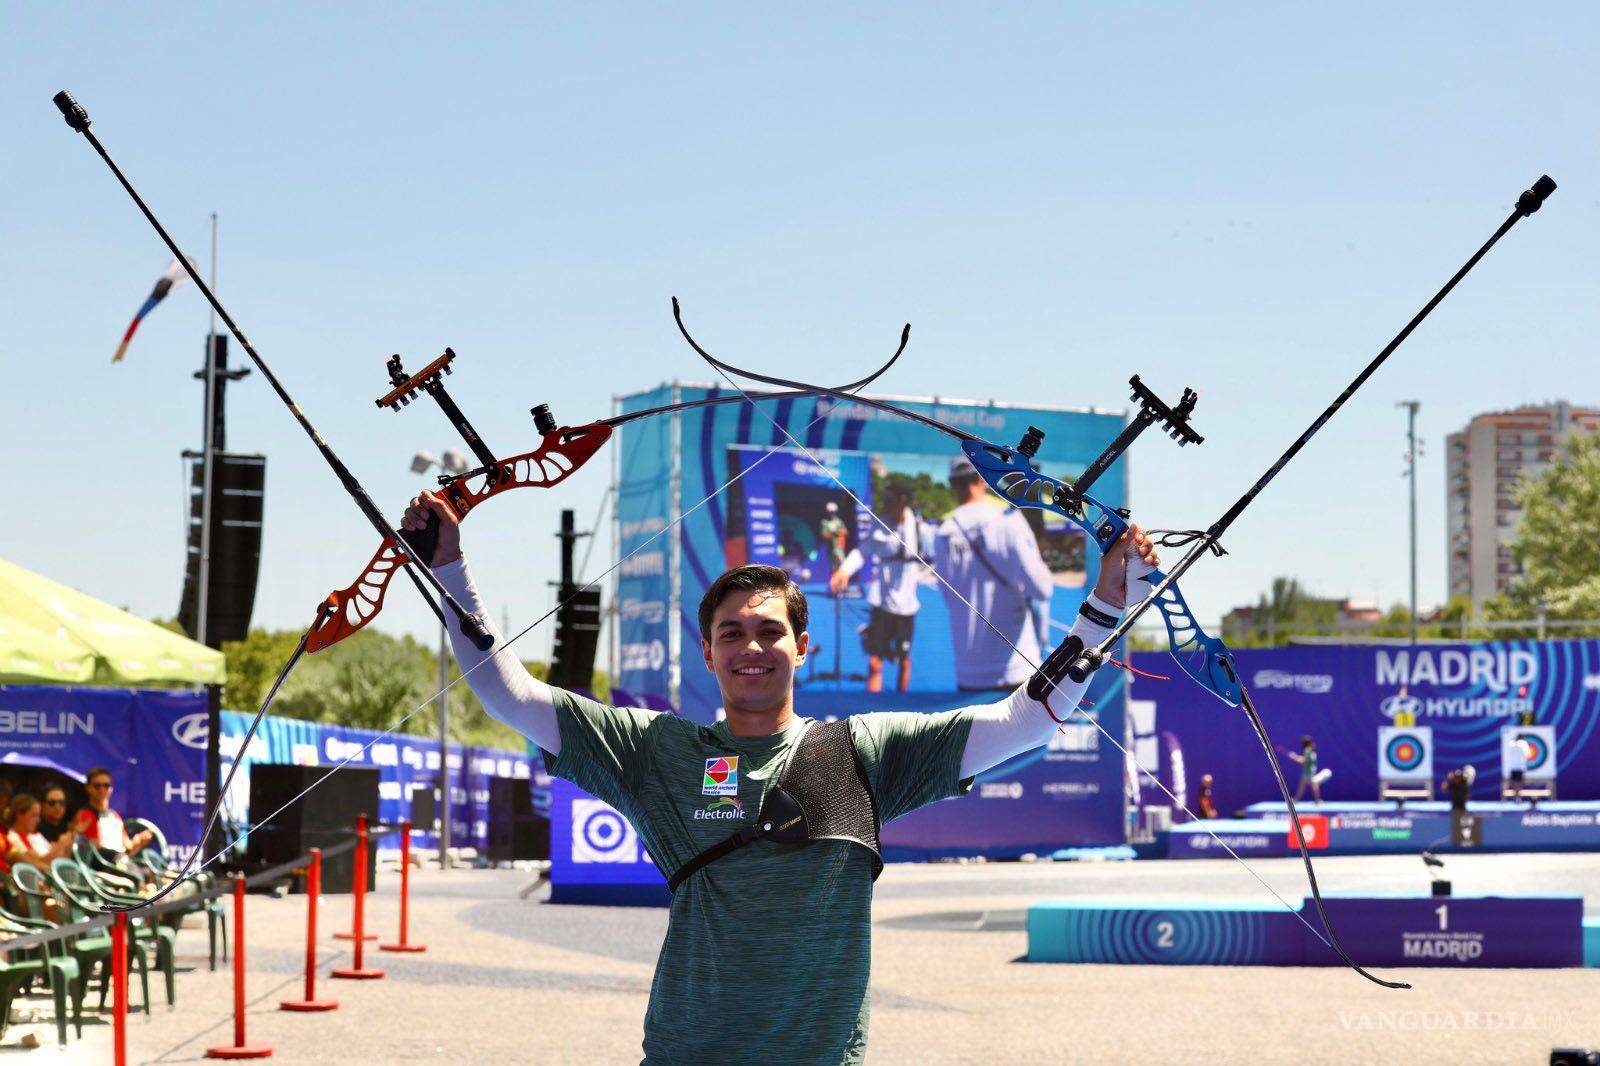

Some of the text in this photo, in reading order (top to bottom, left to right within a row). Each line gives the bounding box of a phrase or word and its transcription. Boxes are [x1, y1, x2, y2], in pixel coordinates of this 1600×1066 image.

[1375, 650, 1538, 692] MADRID
[694, 809, 746, 820] Electrolit
[1435, 905, 1448, 930] 1
[1157, 921, 1174, 948] 2
[1404, 940, 1483, 962] MADRID
